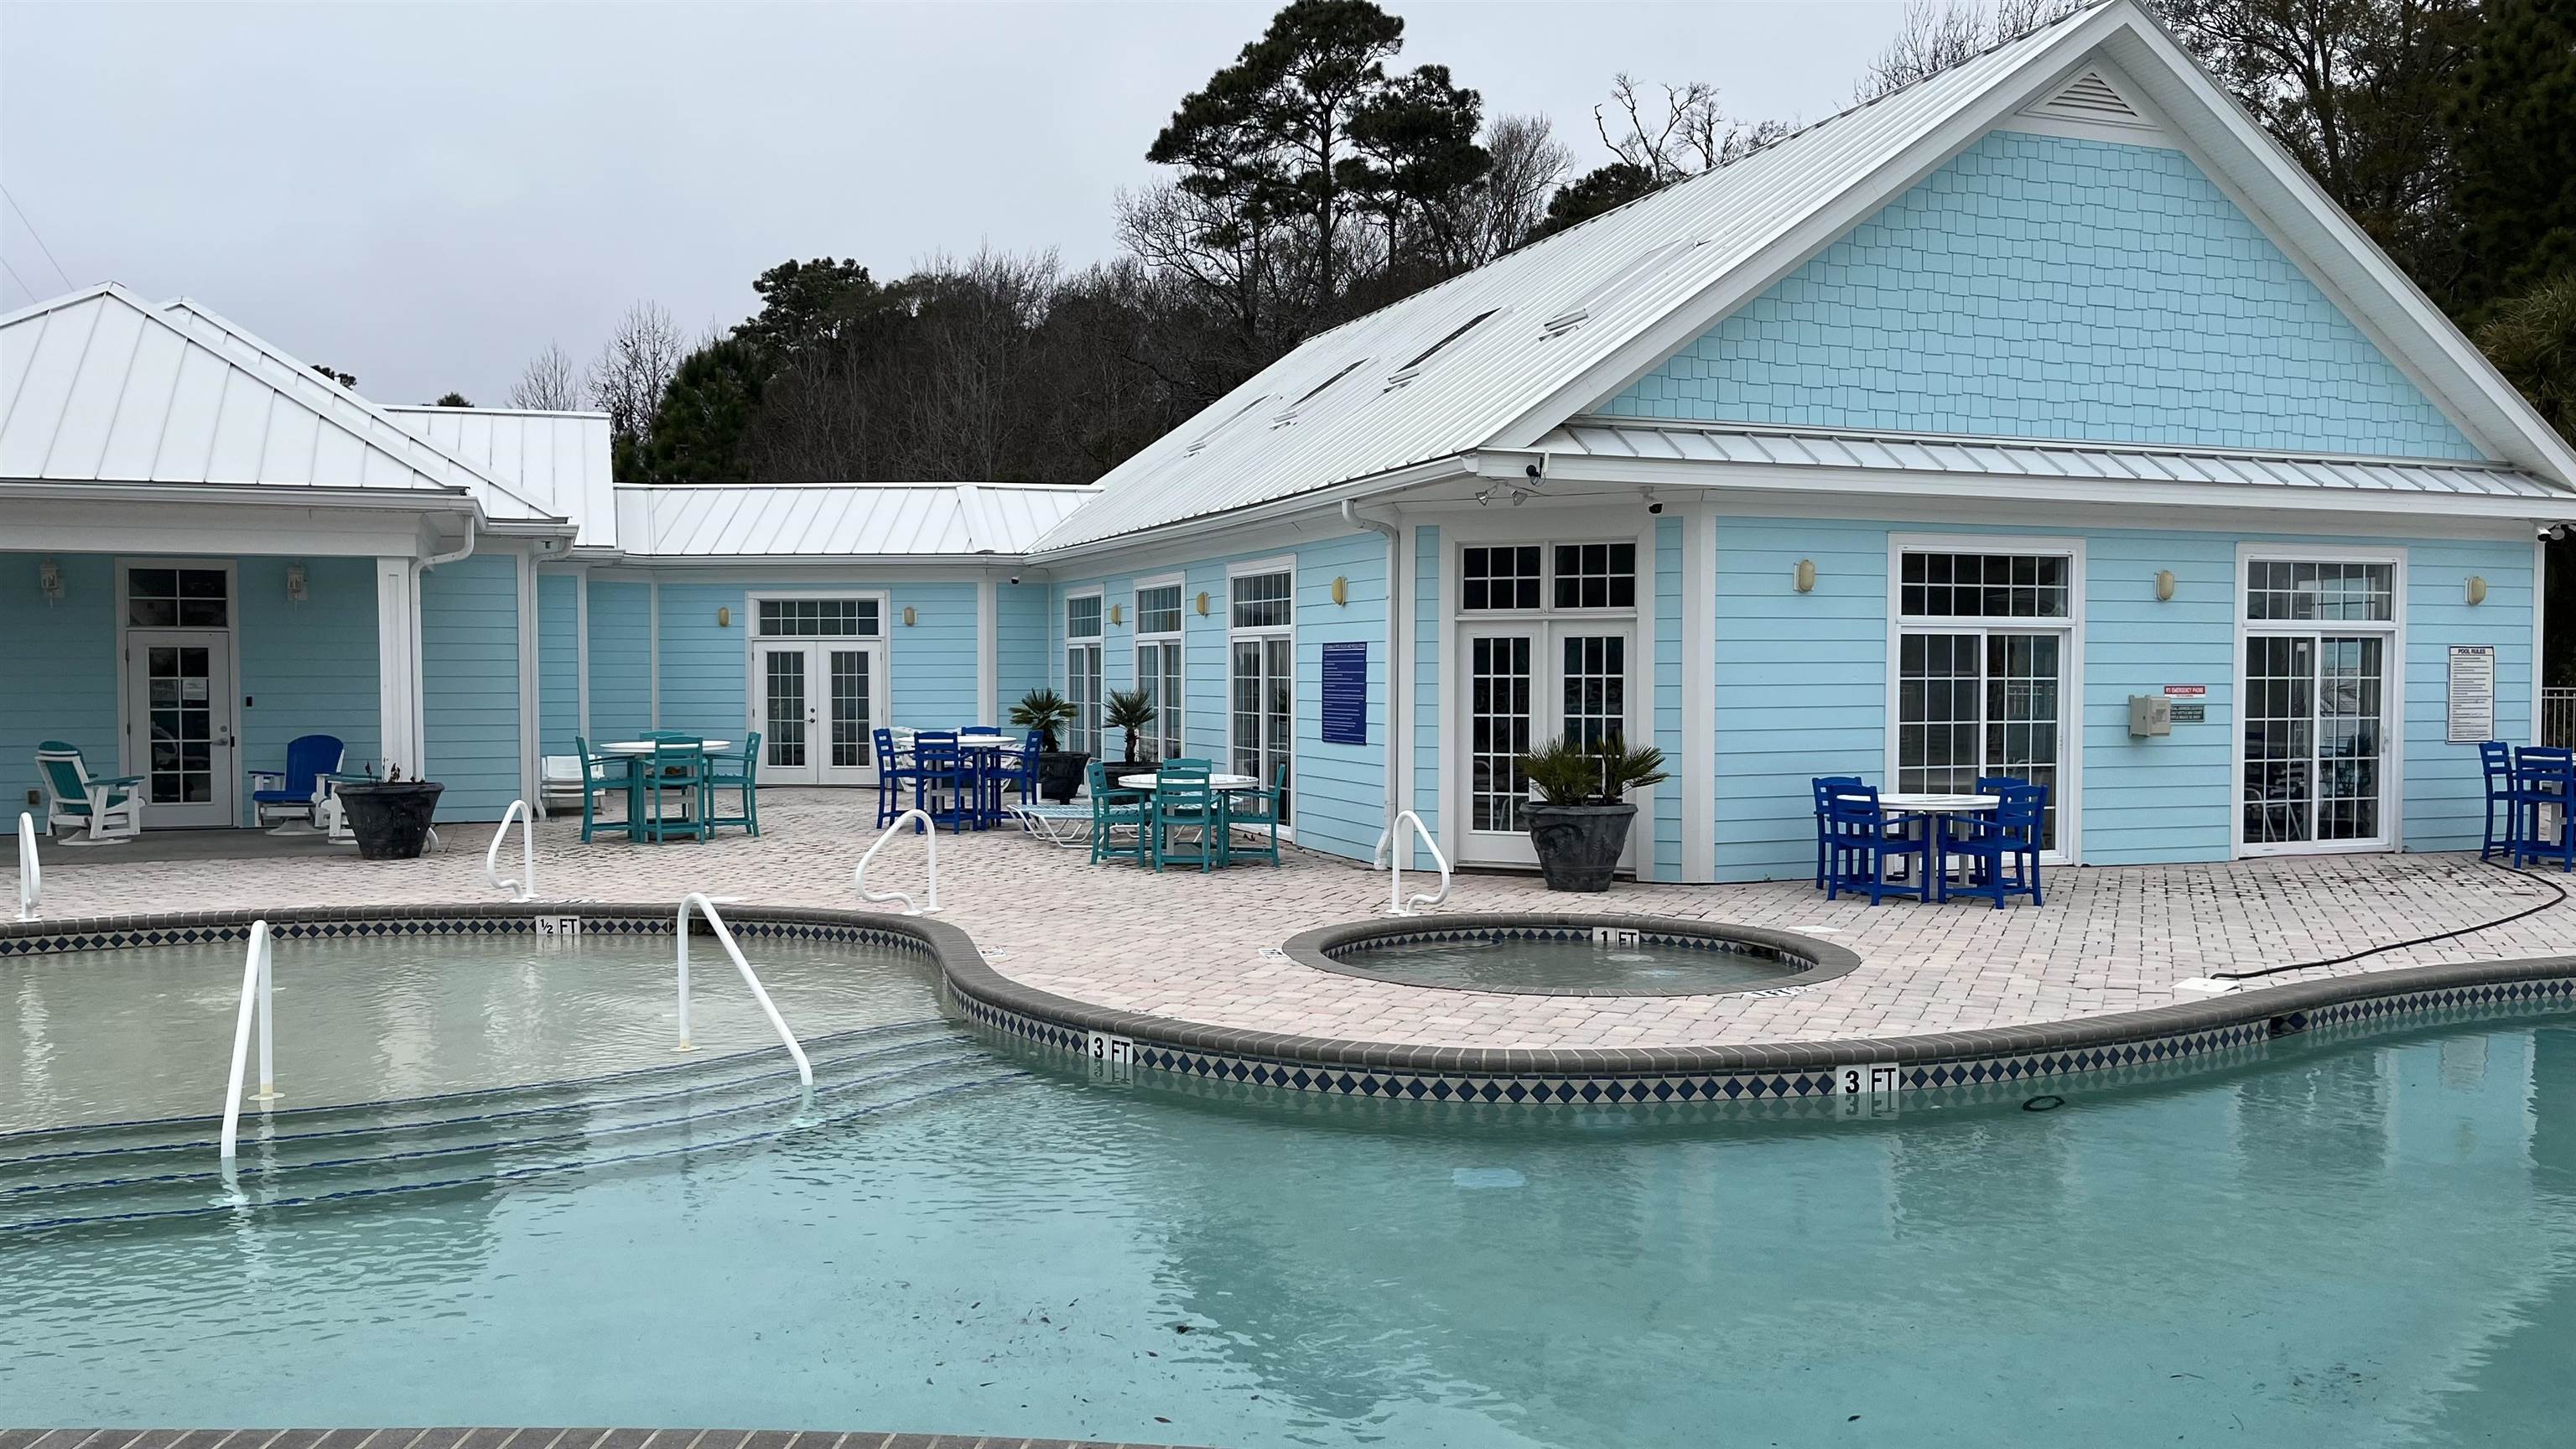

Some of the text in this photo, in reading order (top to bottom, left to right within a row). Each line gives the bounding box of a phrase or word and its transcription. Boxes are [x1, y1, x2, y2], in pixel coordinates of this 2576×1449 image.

[559, 918, 578, 934] FT
[1601, 930, 1637, 943] 1 FT
[1093, 1036, 1130, 1063] 3 FT
[1845, 1067, 1897, 1094] 3 FT
